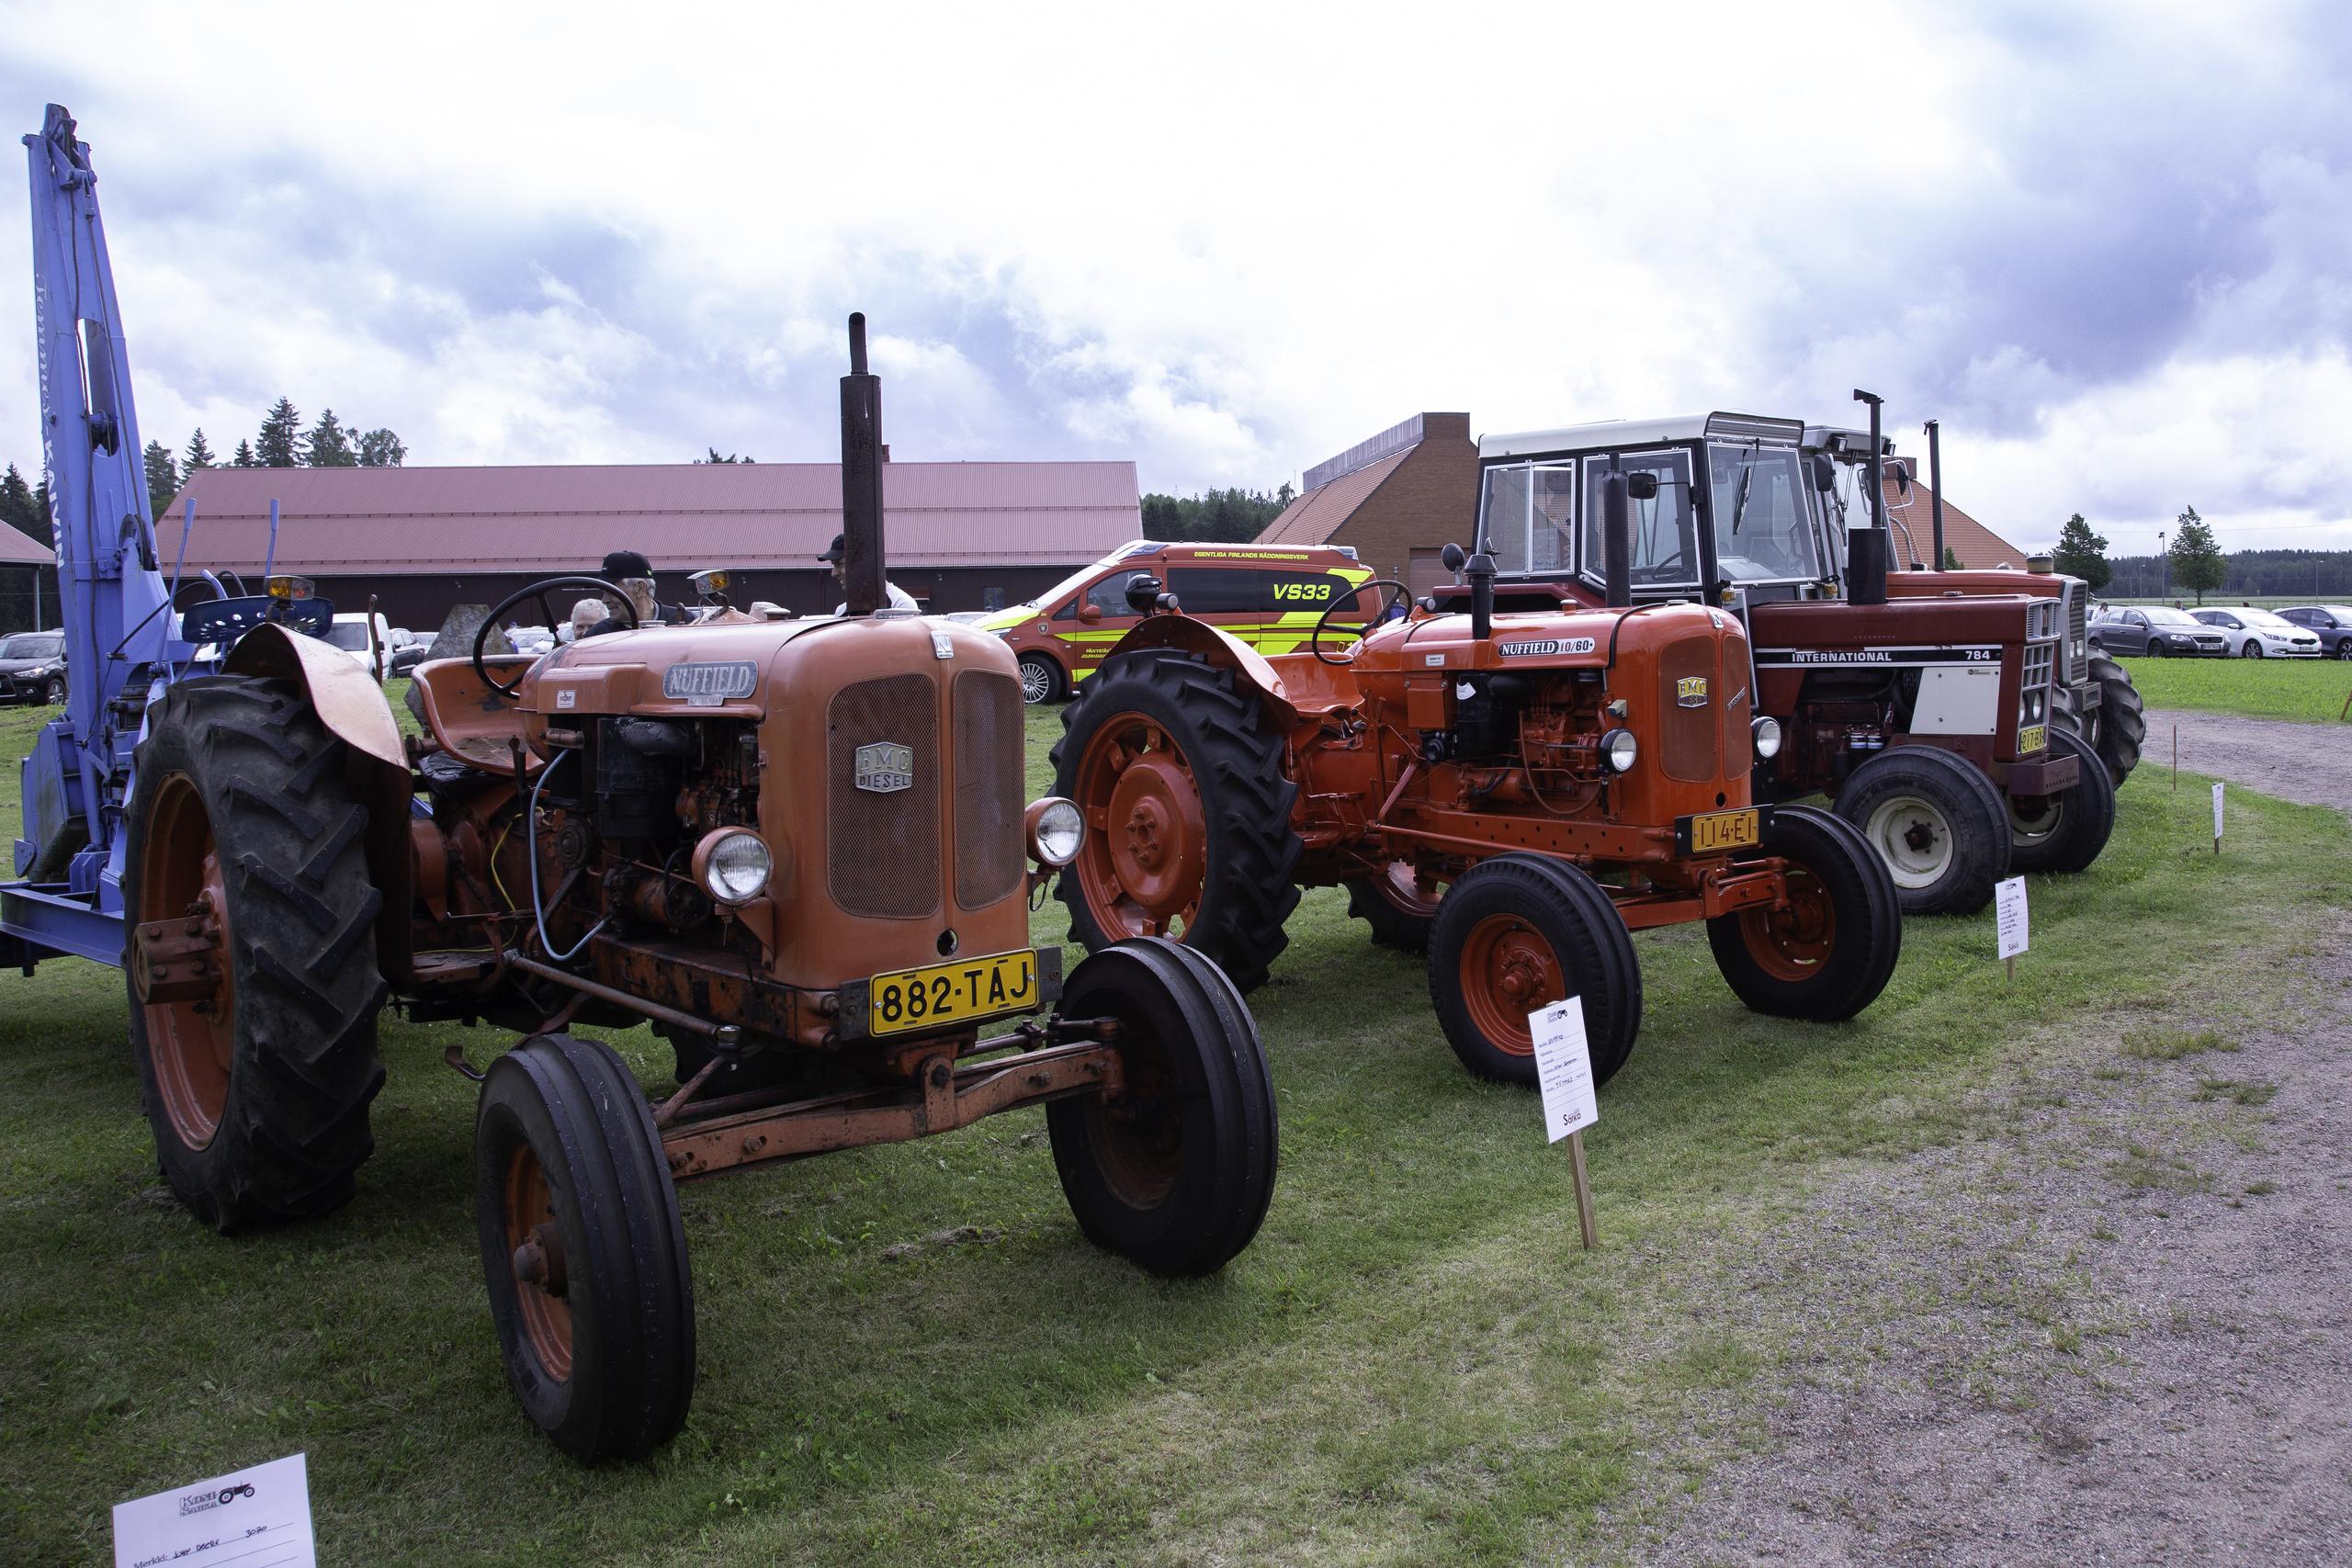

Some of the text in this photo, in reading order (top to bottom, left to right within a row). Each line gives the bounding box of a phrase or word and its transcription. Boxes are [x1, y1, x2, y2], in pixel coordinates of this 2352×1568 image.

[1273, 583, 1331, 600] VS33
[1500, 640, 1589, 656] NUFFIELD 10/60
[1965, 650, 1991, 660] 784
[1792, 651, 1893, 662] INTERNATIONAL
[671, 665, 751, 693] NUFFIELD
[1679, 680, 1706, 694] BMC
[858, 748, 909, 772] BMC
[859, 774, 909, 788] DIESEL
[881, 961, 1028, 1022] 882-TAJ
[196, 1539, 220, 1552] DEERE
[245, 1526, 267, 1538] 3020
